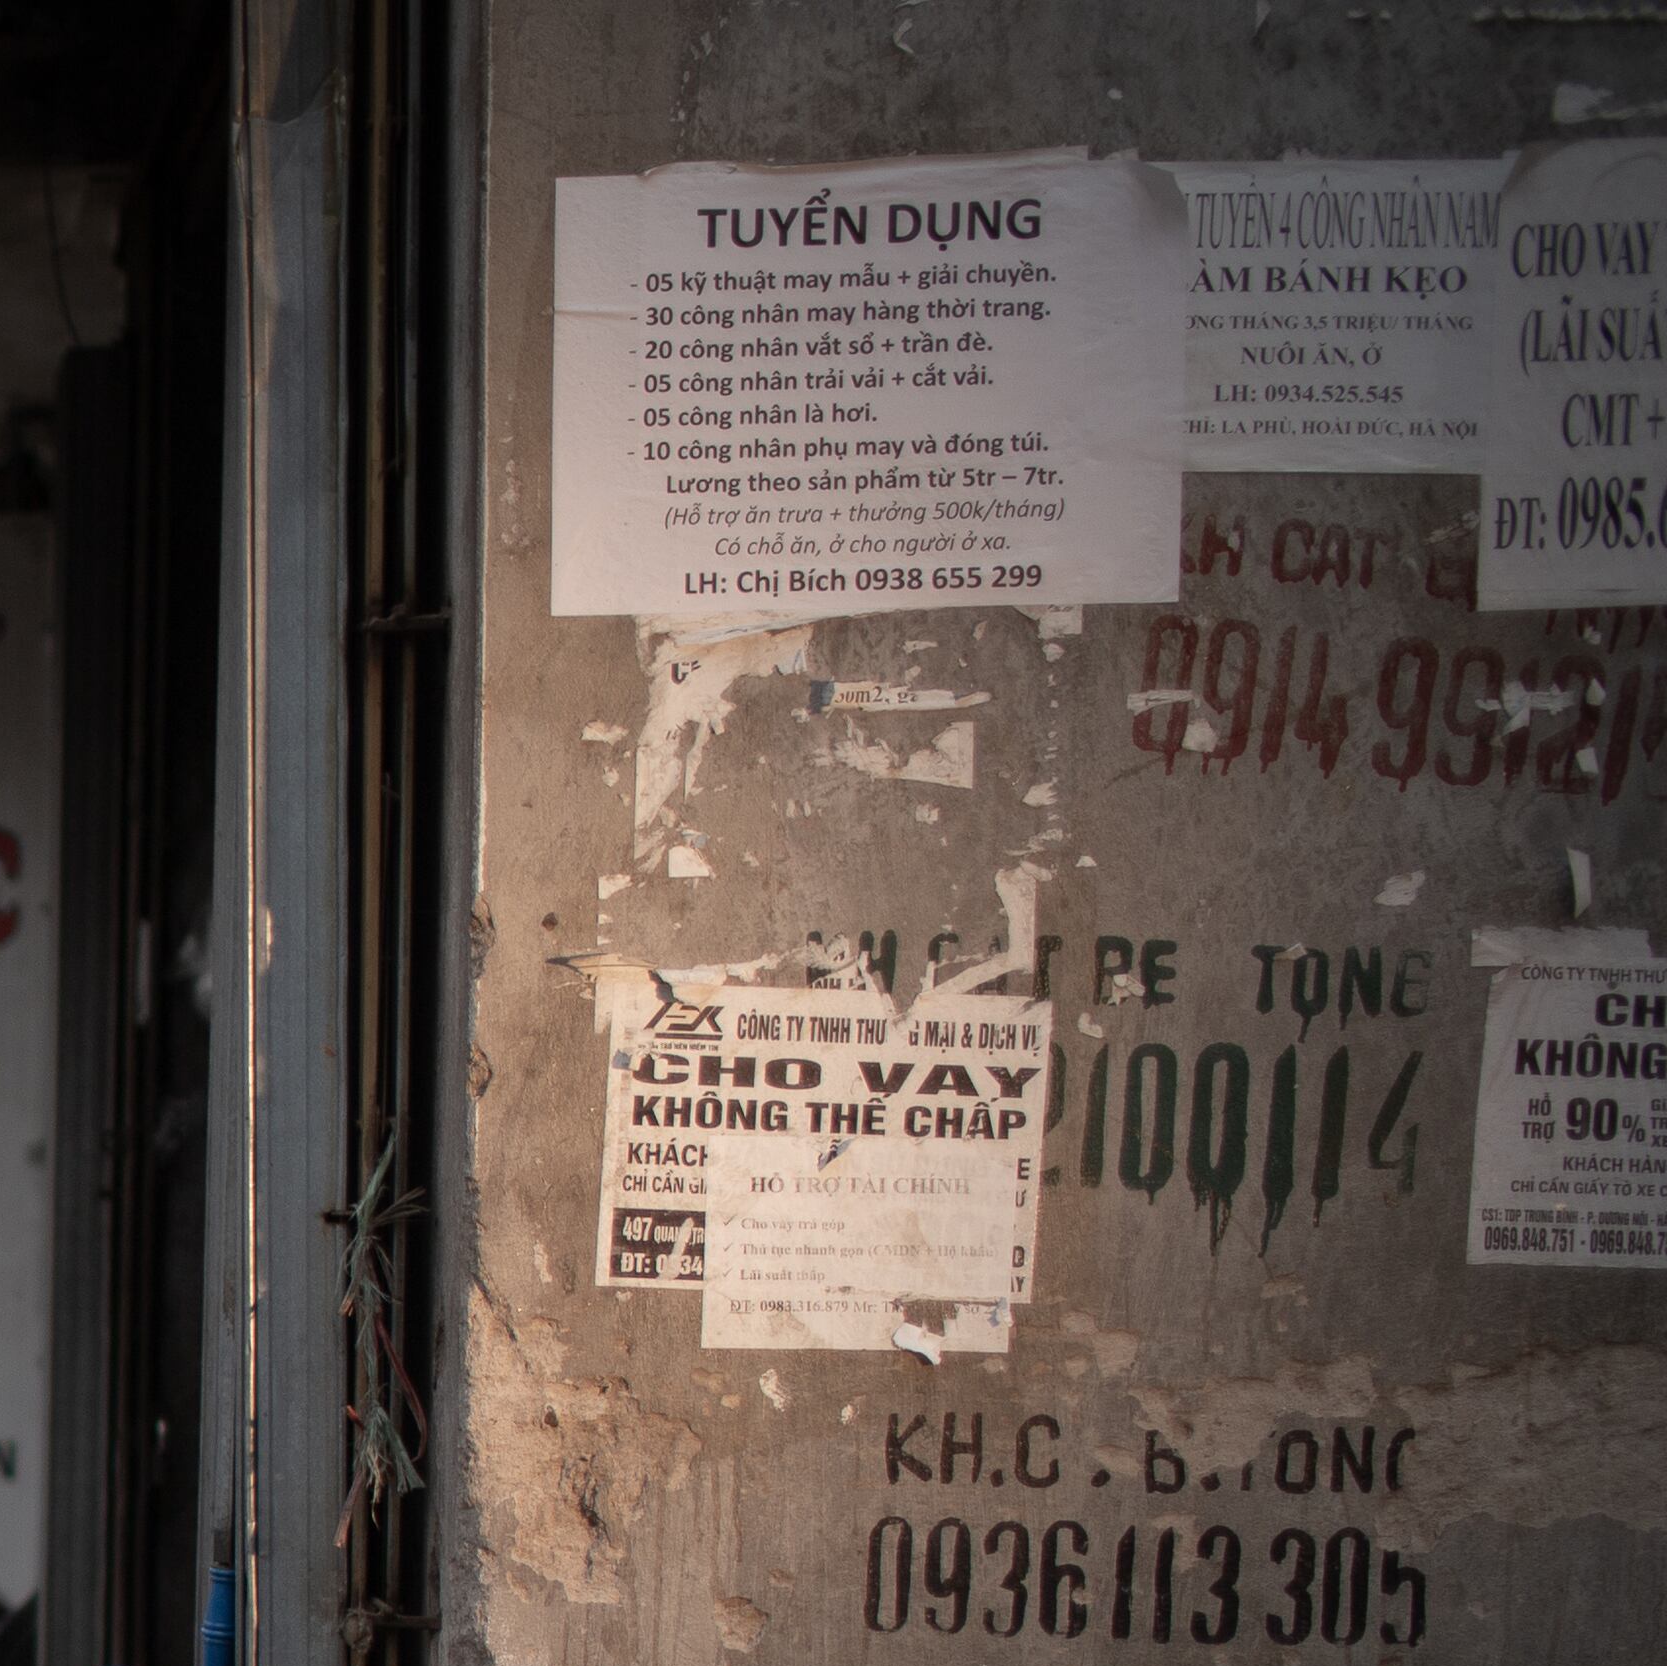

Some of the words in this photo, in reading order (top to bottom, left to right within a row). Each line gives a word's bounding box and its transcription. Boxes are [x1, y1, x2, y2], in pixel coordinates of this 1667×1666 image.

[697, 188, 867, 248] TUYỂN
[888, 198, 1043, 251] DỤNG
[1297, 175, 1365, 248] CÔNG
[1369, 175, 1440, 248] NHÂN
[1444, 192, 1501, 248] NAM
[1511, 222, 1586, 279] CHO
[1595, 220, 1659, 276] VAY
[1186, 258, 1251, 292] ÀM
[1265, 257, 1370, 293] BÁNH
[1383, 265, 1467, 300] KẸO
[645, 307, 673, 326] 30
[681, 305, 734, 329] công
[742, 304, 799, 324] nhân
[807, 306, 856, 325] may
[863, 301, 920, 323] hàng
[927, 299, 975, 320] thời
[983, 300, 1051, 321] trang.
[1597, 290, 1667, 363] SUẤ
[1241, 344, 1306, 365] NUÔI
[1215, 384, 1257, 403] LH:
[1264, 385, 1403, 404] 0934.525.545
[643, 408, 670, 426] 05
[678, 406, 732, 429] công
[740, 405, 797, 425] nhân
[805, 403, 823, 423] là
[832, 403, 877, 422] hơi.
[1562, 393, 1639, 448] CMT
[643, 442, 670, 460] 10
[678, 440, 731, 463] công
[739, 438, 796, 459] nhân
[804, 437, 848, 461] phụ
[856, 440, 904, 460] may
[911, 434, 937, 454] và
[944, 433, 1004, 457] đóng
[1011, 431, 1049, 452] túi.
[667, 472, 740, 497] Lương
[748, 472, 800, 492] theo
[808, 469, 847, 491] sản
[855, 466, 919, 494] phẩm
[928, 468, 955, 487] từ
[962, 468, 996, 487] 5tr
[1024, 467, 1064, 486] 7tr.
[1493, 496, 1547, 551] ĐT:
[685, 572, 727, 594] LH:
[737, 570, 779, 597] Chị
[789, 569, 846, 592] Bích
[855, 568, 923, 591] 0938
[932, 566, 982, 589] 655
[991, 564, 1042, 588] 299
[1132, 613, 1348, 778] 0914
[737, 1009, 781, 1041] CÔNG
[787, 1015, 805, 1042] TY
[810, 1016, 851, 1044] TNHH
[857, 1018, 918, 1046] THƯG
[961, 1023, 972, 1049] &
[633, 1053, 821, 1090] CHO
[858, 1061, 1042, 1098] VAY
[1515, 1033, 1667, 1080] KHÔNG
[633, 1091, 788, 1132] KHÔNG
[806, 1093, 891, 1136] THẾ
[904, 1097, 1027, 1140] CHẤP
[622, 1169, 647, 1193] CHỈ
[652, 1166, 685, 1194] CẦN
[622, 1216, 652, 1242] 497
